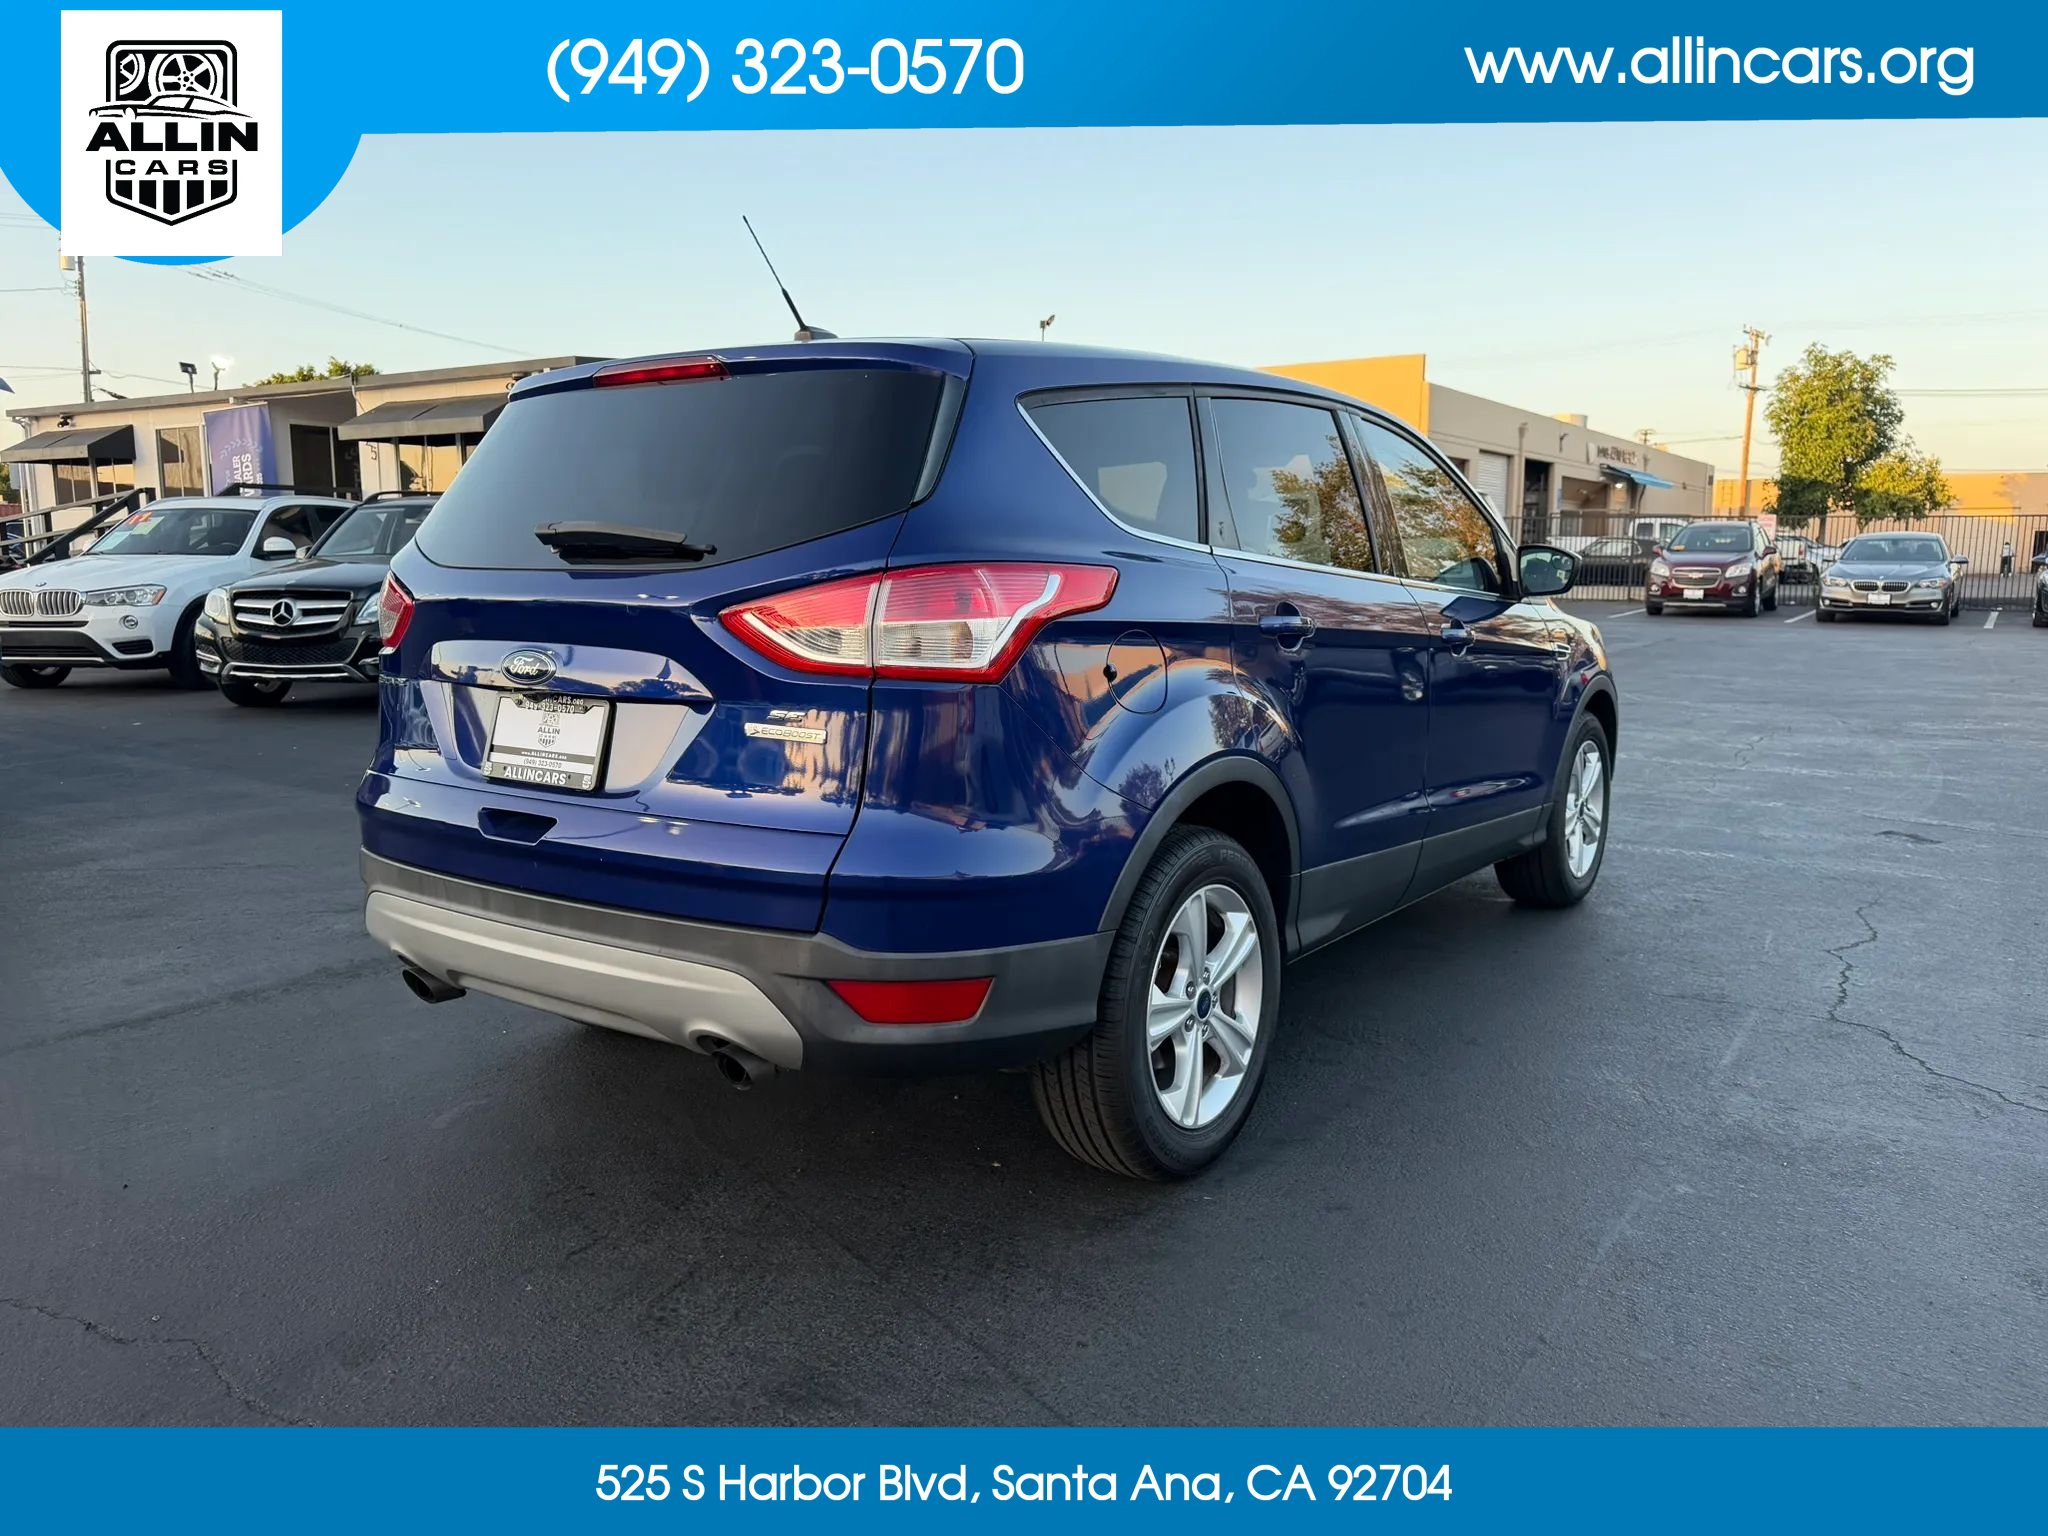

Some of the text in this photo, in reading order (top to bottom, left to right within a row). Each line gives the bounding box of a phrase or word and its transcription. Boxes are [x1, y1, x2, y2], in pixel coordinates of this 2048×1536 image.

[510, 656, 539, 675] Ford
[767, 709, 807, 721] SE
[537, 726, 561, 735] ALLIN
[761, 726, 821, 740] ECOBOOST
[504, 766, 567, 785] ALLINCARS
